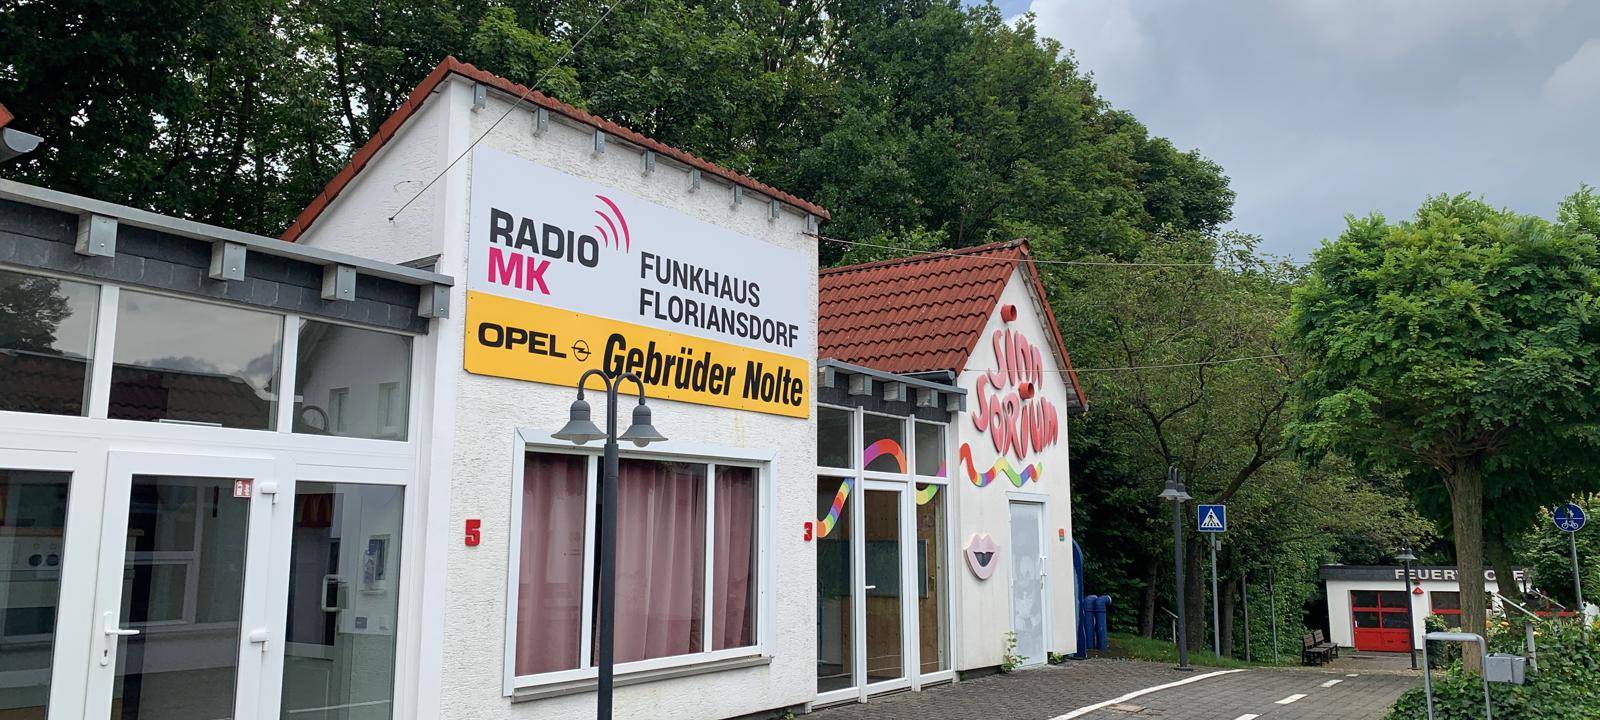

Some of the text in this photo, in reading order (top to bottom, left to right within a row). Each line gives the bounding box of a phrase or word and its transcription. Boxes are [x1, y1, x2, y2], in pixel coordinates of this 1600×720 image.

[490, 207, 599, 268] RADIO
[488, 246, 551, 295] MK
[641, 251, 760, 307] FUNKHAUS
[639, 287, 799, 348] FLORIANSDORF
[478, 322, 803, 407] OPEL Gebrüder Nolte
[465, 519, 481, 546] 5
[803, 521, 813, 541] 3
[1394, 569, 1524, 581] FEUERCE
